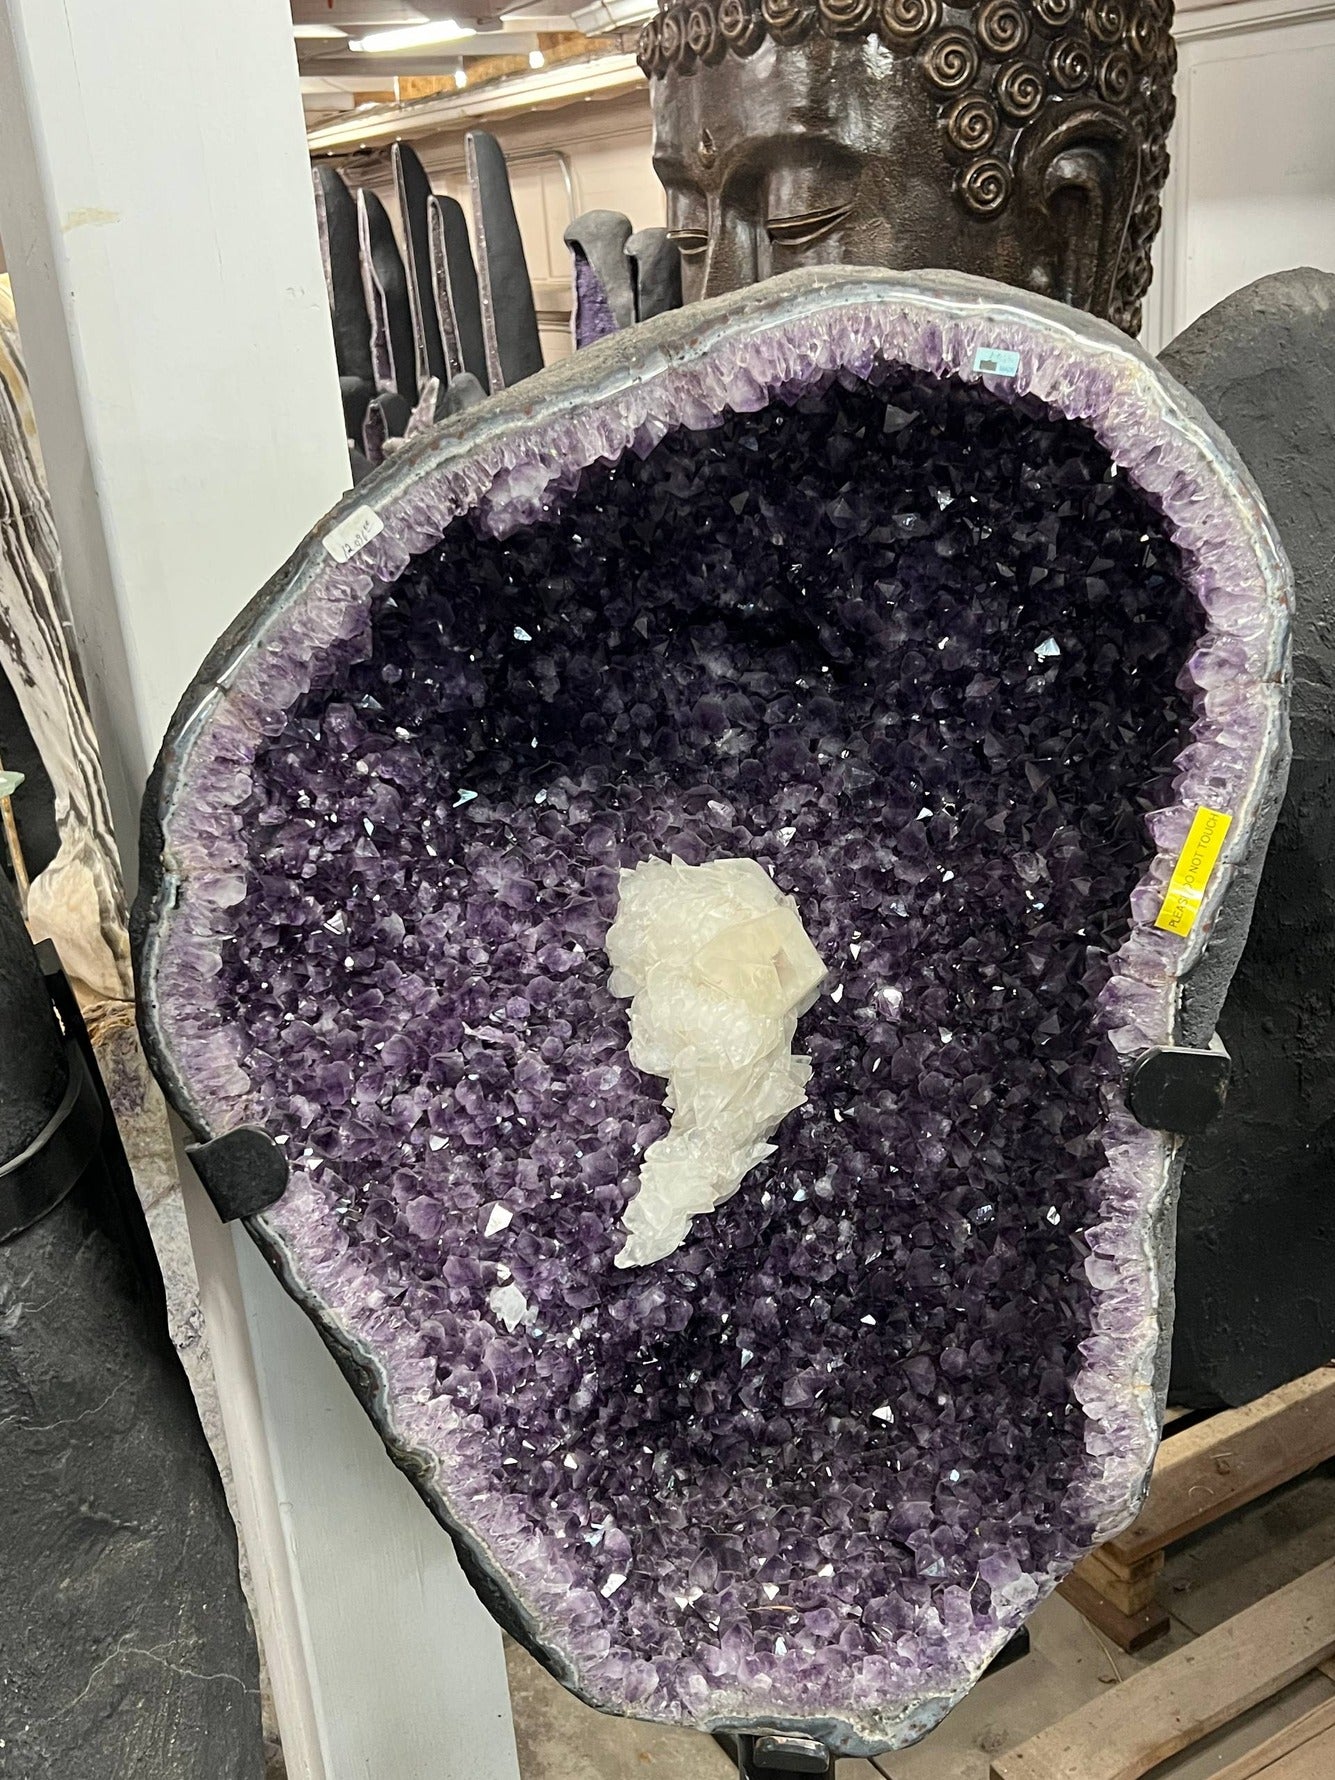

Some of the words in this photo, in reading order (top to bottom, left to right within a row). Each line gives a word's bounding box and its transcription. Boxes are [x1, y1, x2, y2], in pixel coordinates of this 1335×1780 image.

[1168, 891, 1191, 928] PLEAS
[1189, 852, 1204, 875] NOT
[1198, 813, 1220, 849] TOUCH
